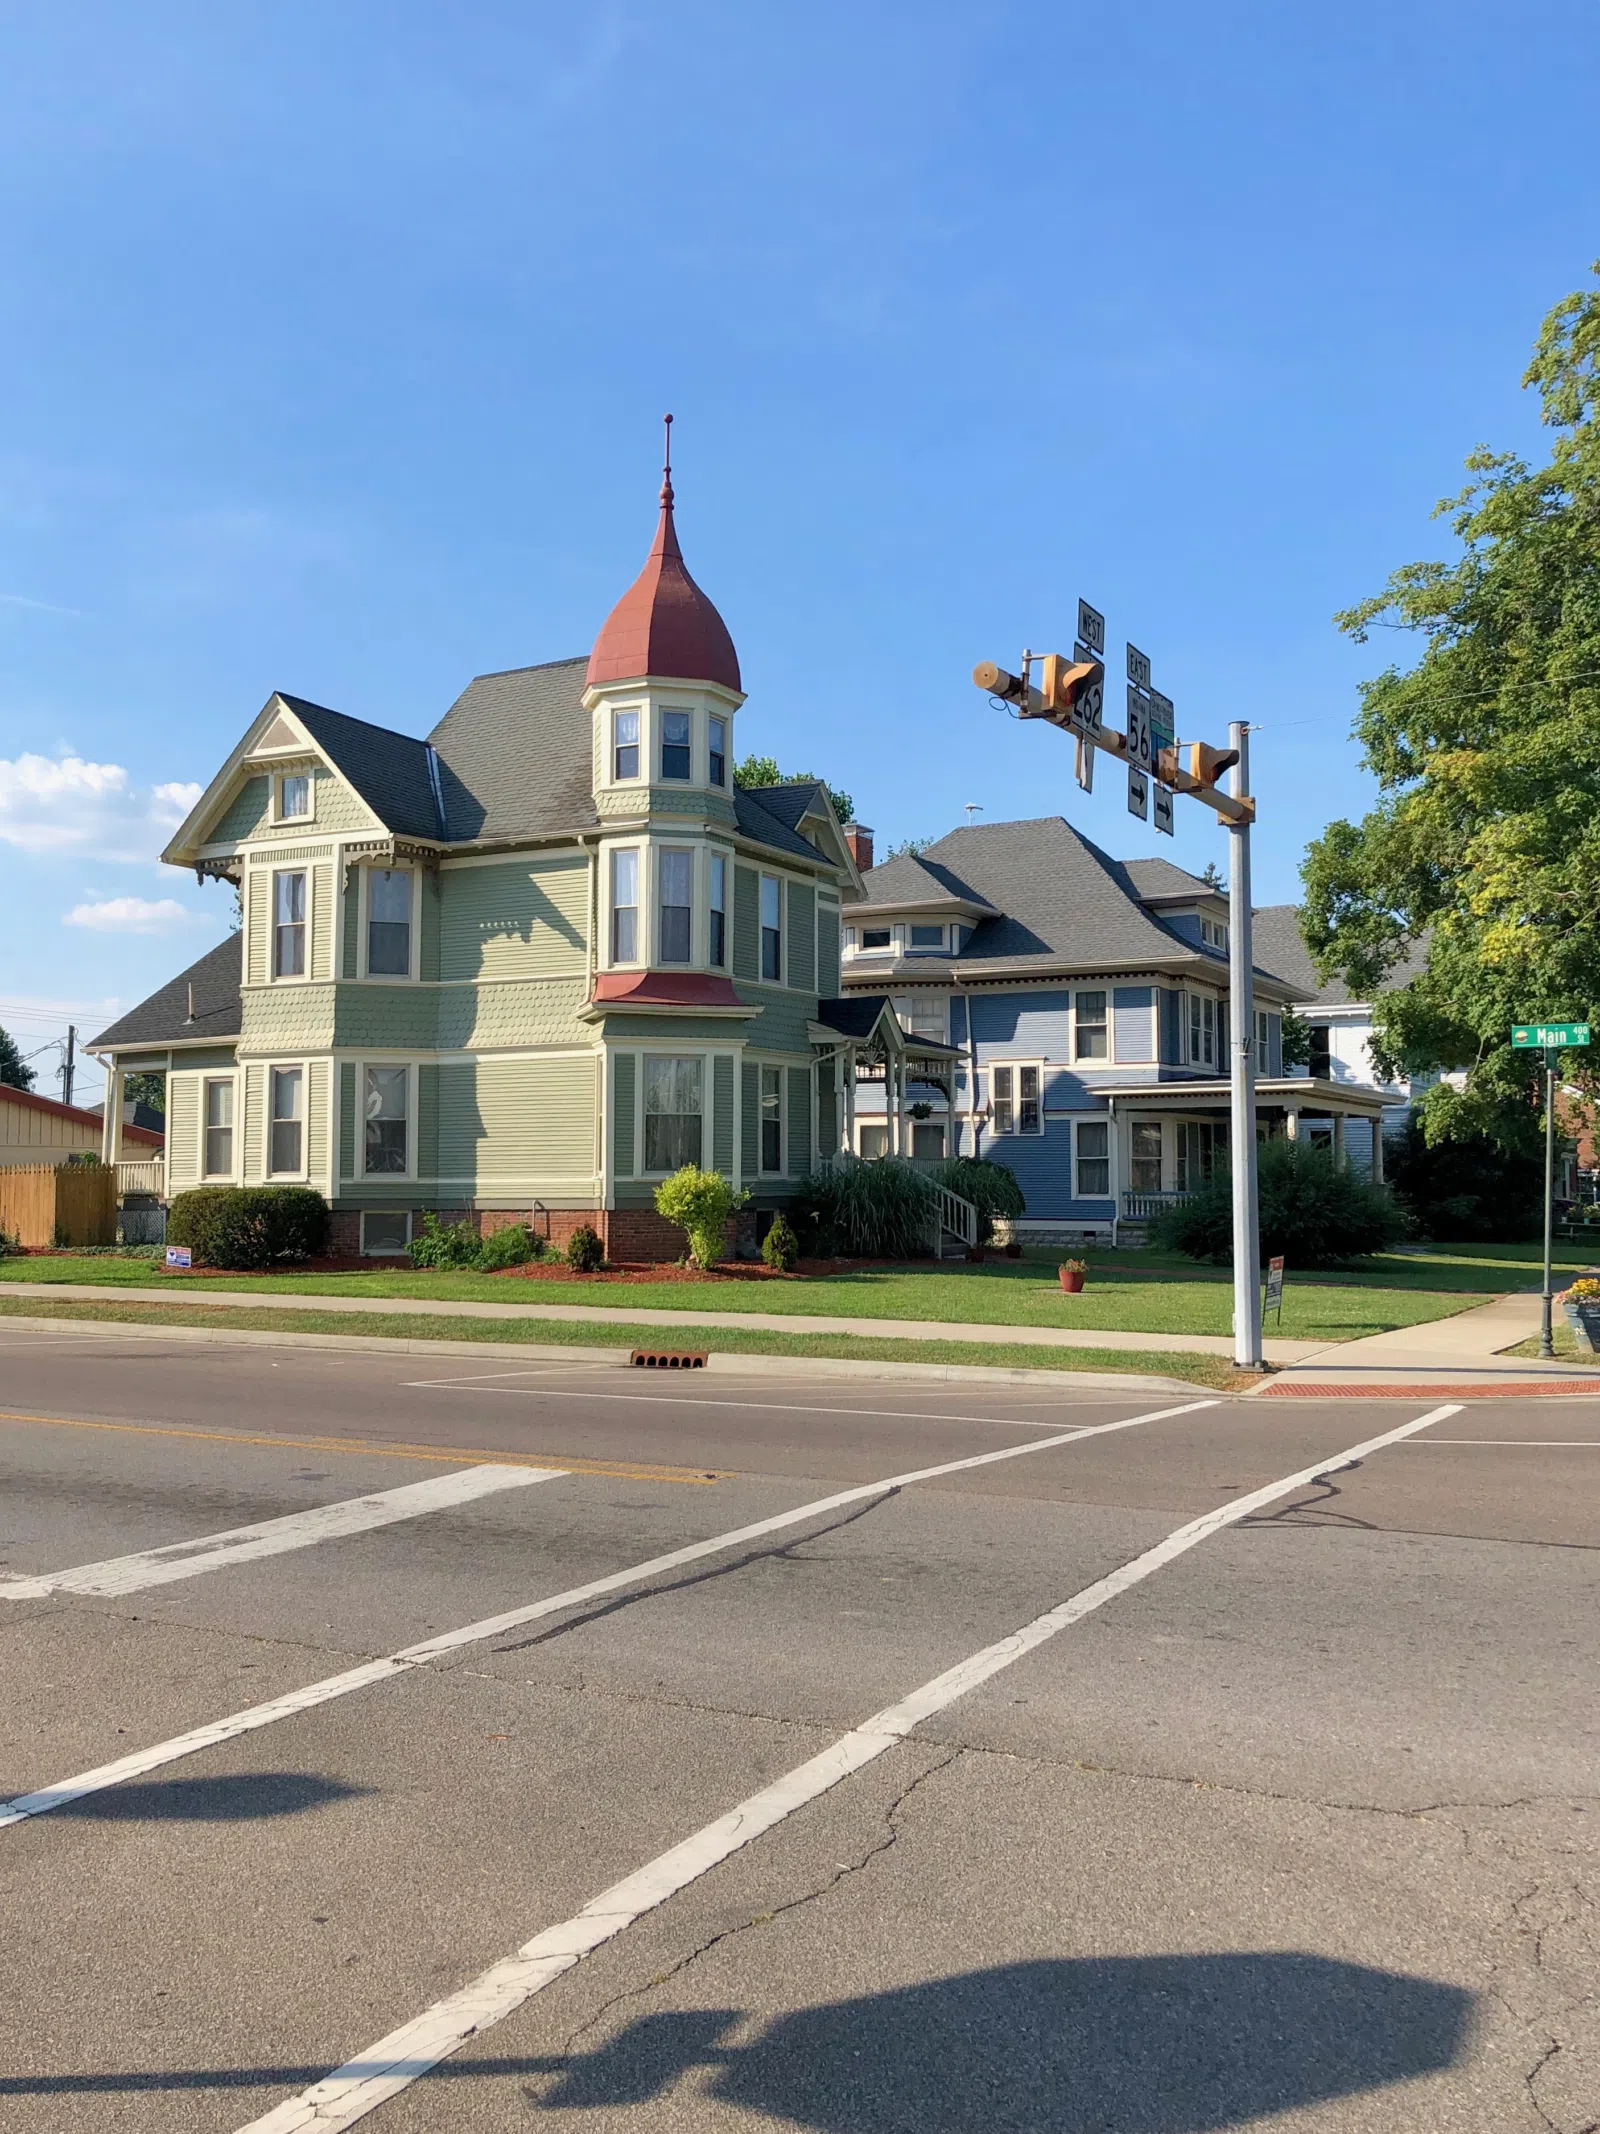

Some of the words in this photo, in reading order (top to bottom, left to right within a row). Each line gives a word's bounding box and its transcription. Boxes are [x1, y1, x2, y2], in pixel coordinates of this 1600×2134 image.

[1083, 610, 1101, 643] WEST
[1130, 653, 1147, 683] EAST
[1130, 713, 1149, 761] 56
[1537, 1028, 1567, 1044] Main
[1573, 1026, 1588, 1035] 400
